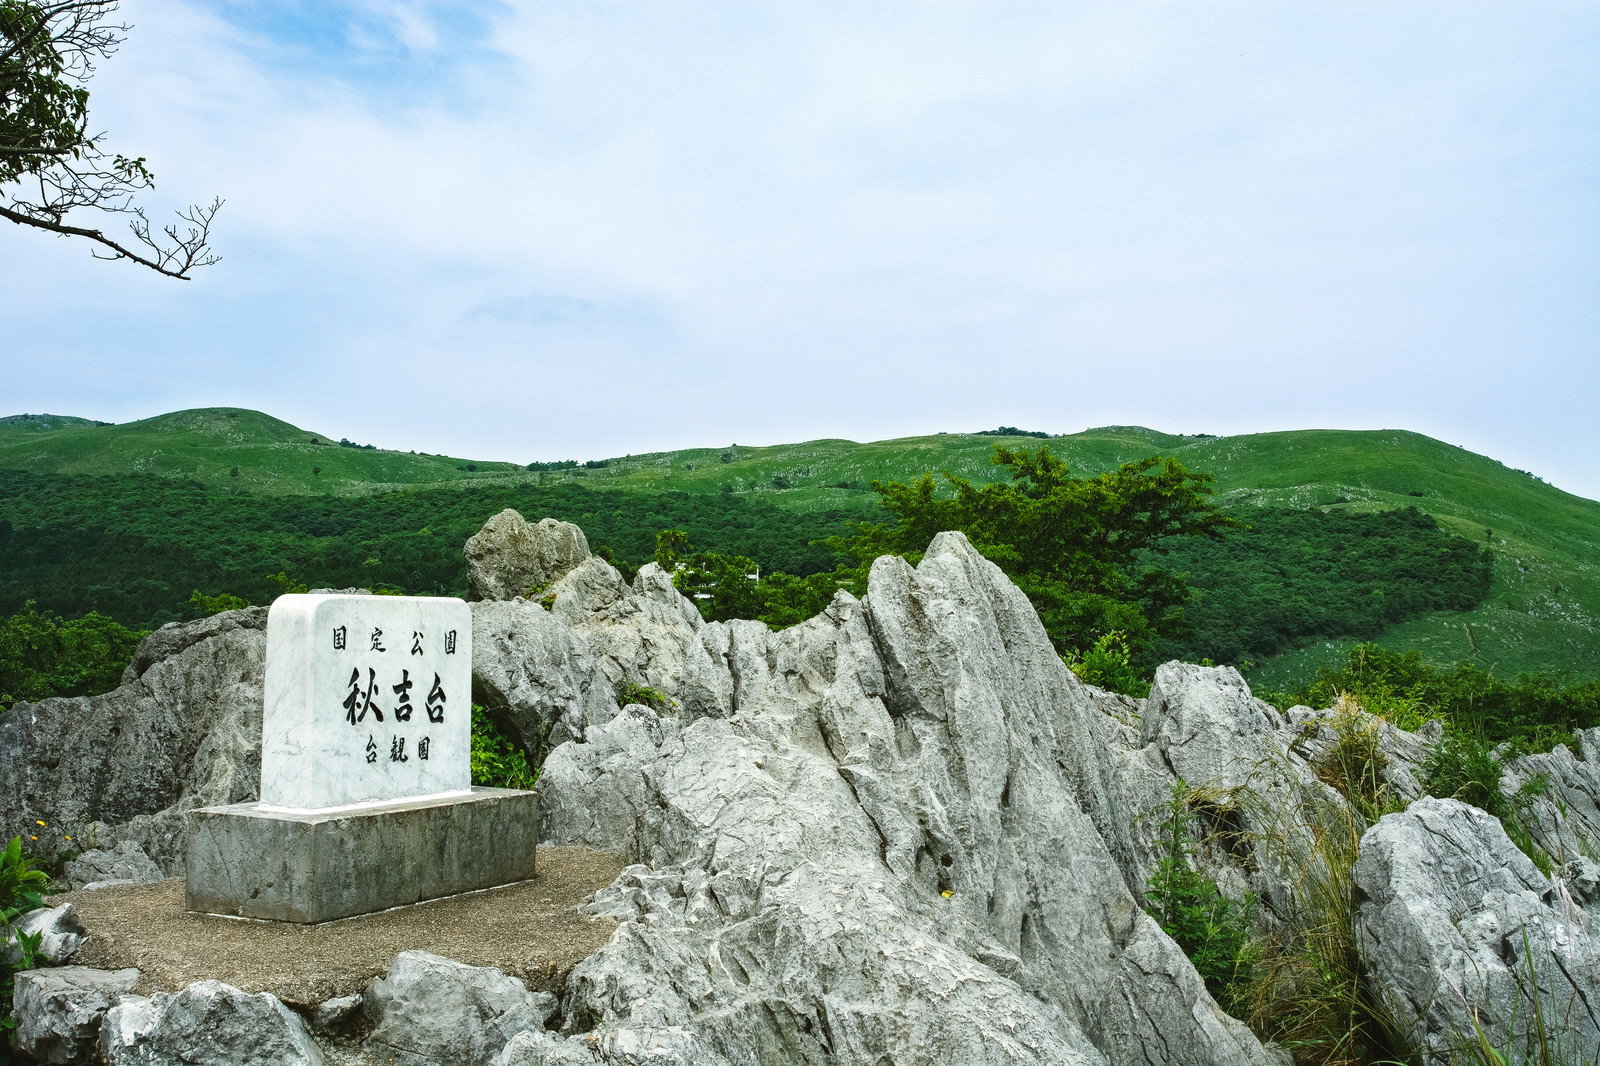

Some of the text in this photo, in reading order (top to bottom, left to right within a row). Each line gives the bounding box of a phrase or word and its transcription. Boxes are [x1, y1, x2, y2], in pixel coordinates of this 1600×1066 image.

[333, 625, 457, 656] 国定公園
[342, 667, 447, 726] 秋吉台
